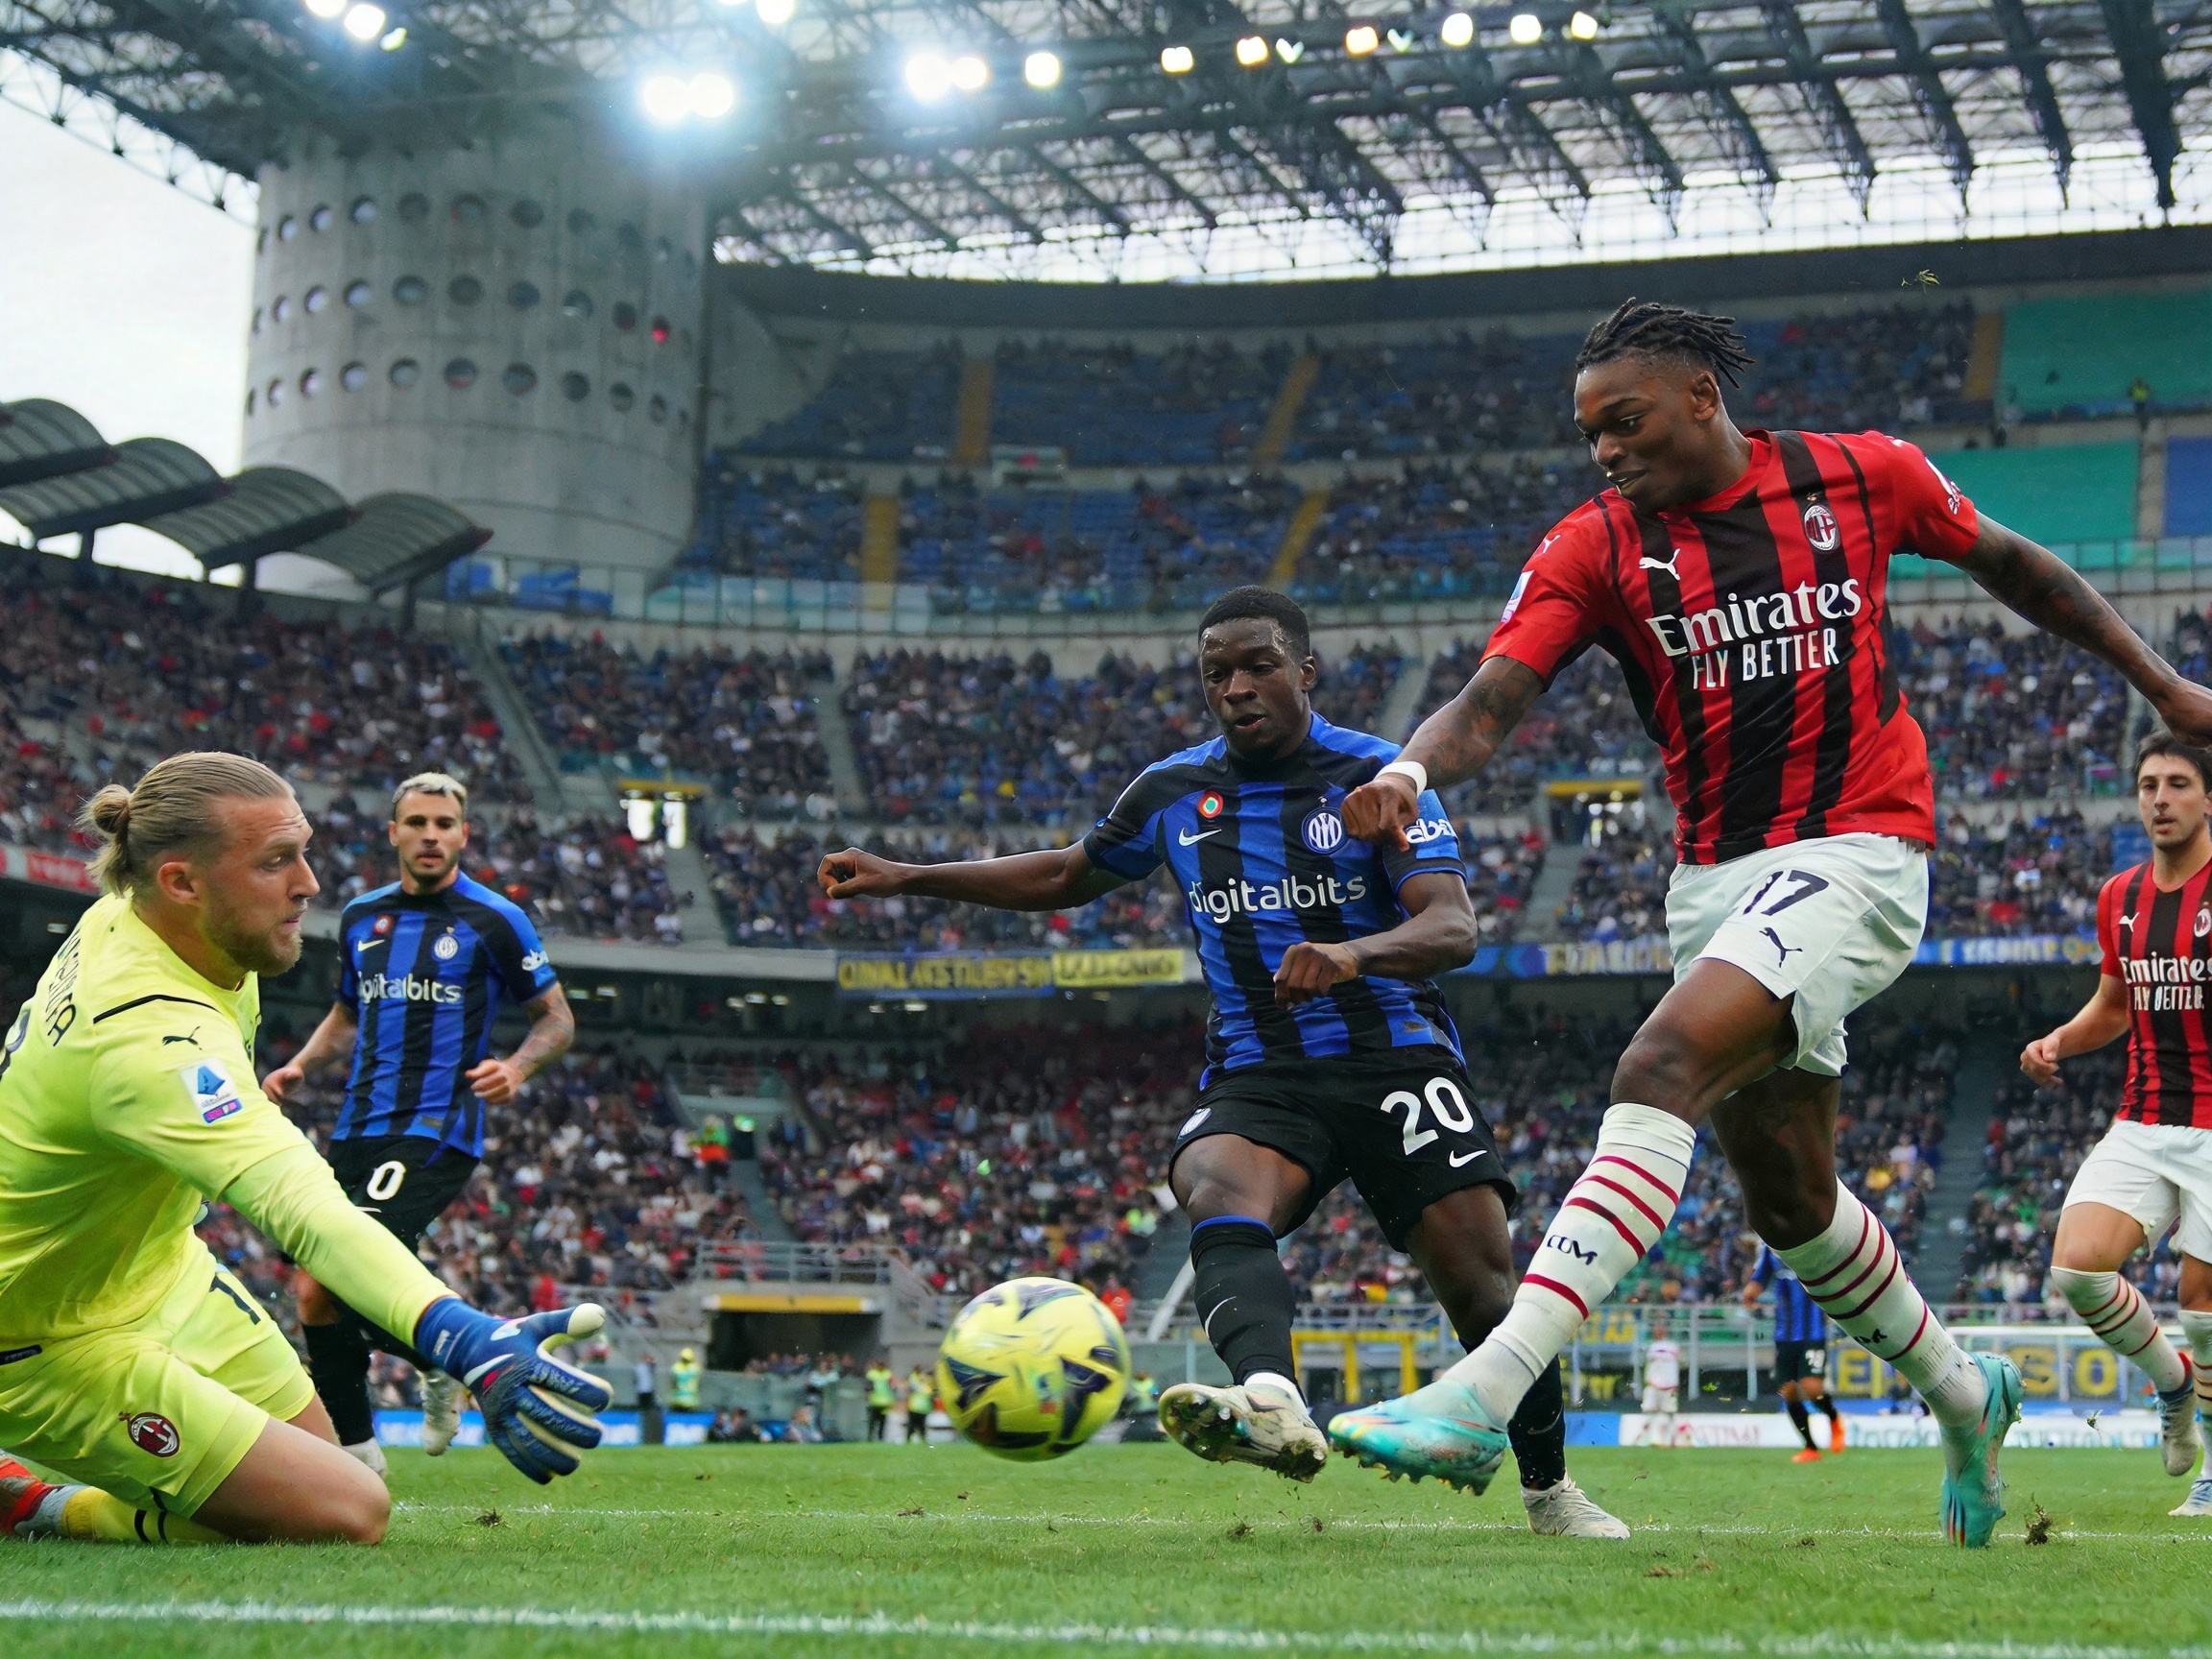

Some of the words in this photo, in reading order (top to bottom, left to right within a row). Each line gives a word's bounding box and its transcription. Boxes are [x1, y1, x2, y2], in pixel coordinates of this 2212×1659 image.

[1645, 578, 1862, 658] Emirates
[1692, 648, 1729, 690] FLY
[1743, 627, 1840, 682] BETTER
[1188, 874, 1368, 924] digitalbits
[1742, 869, 1830, 917] 17
[1380, 1076, 1475, 1156] 20
